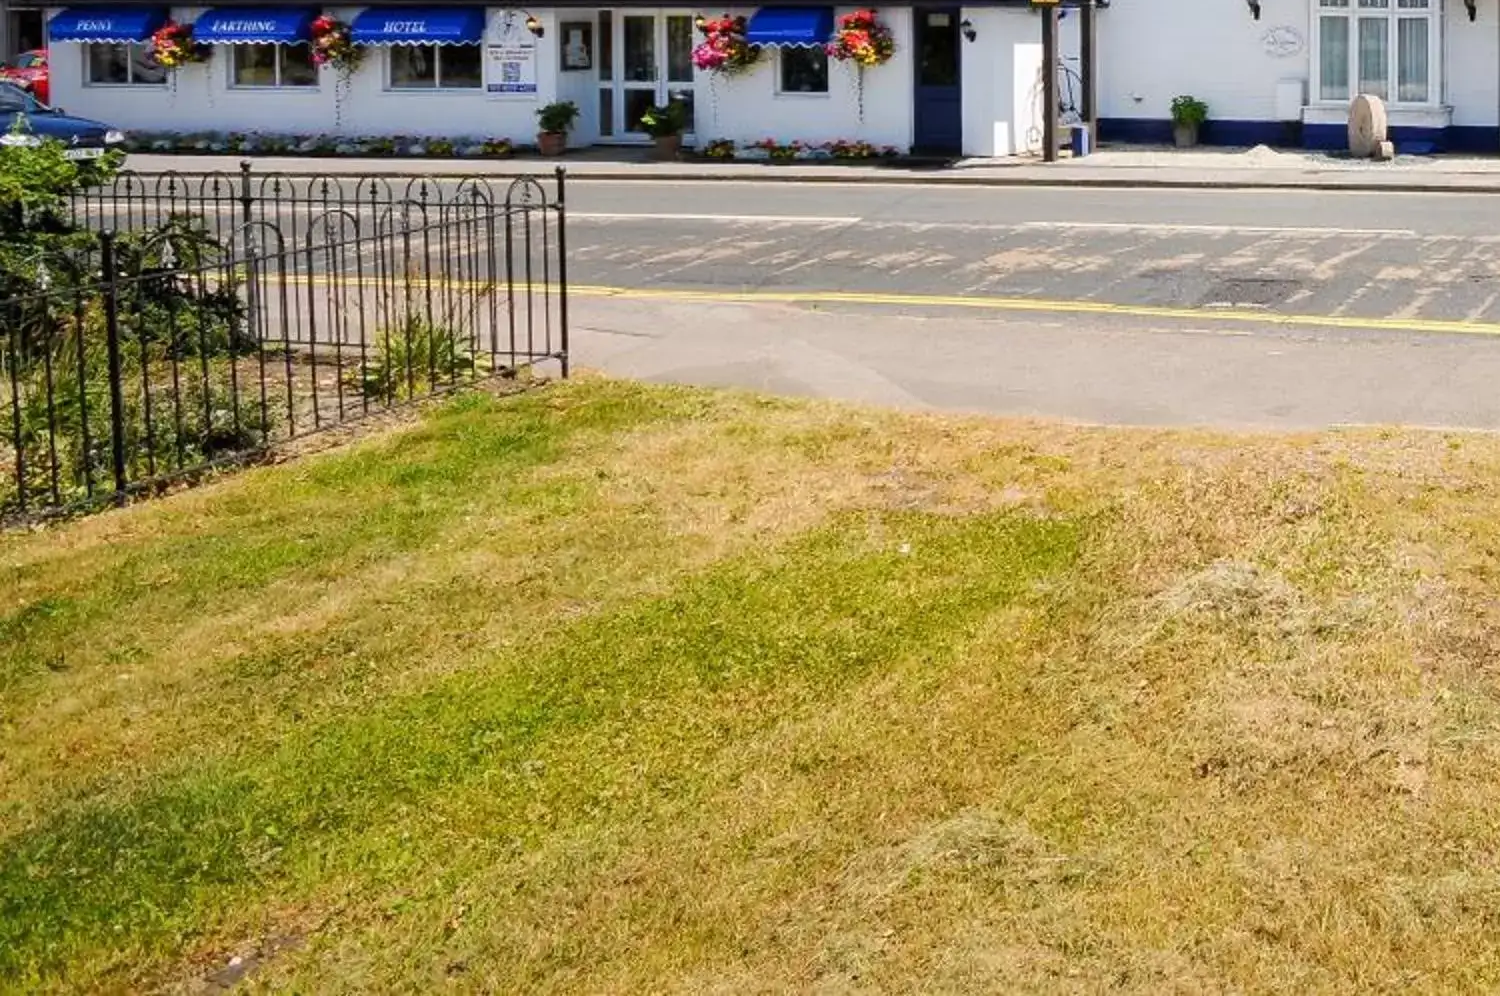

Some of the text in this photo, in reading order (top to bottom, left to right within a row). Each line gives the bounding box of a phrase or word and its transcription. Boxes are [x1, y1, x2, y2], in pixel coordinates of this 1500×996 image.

[76, 19, 427, 34] PENNY FARTHING HOTEL
